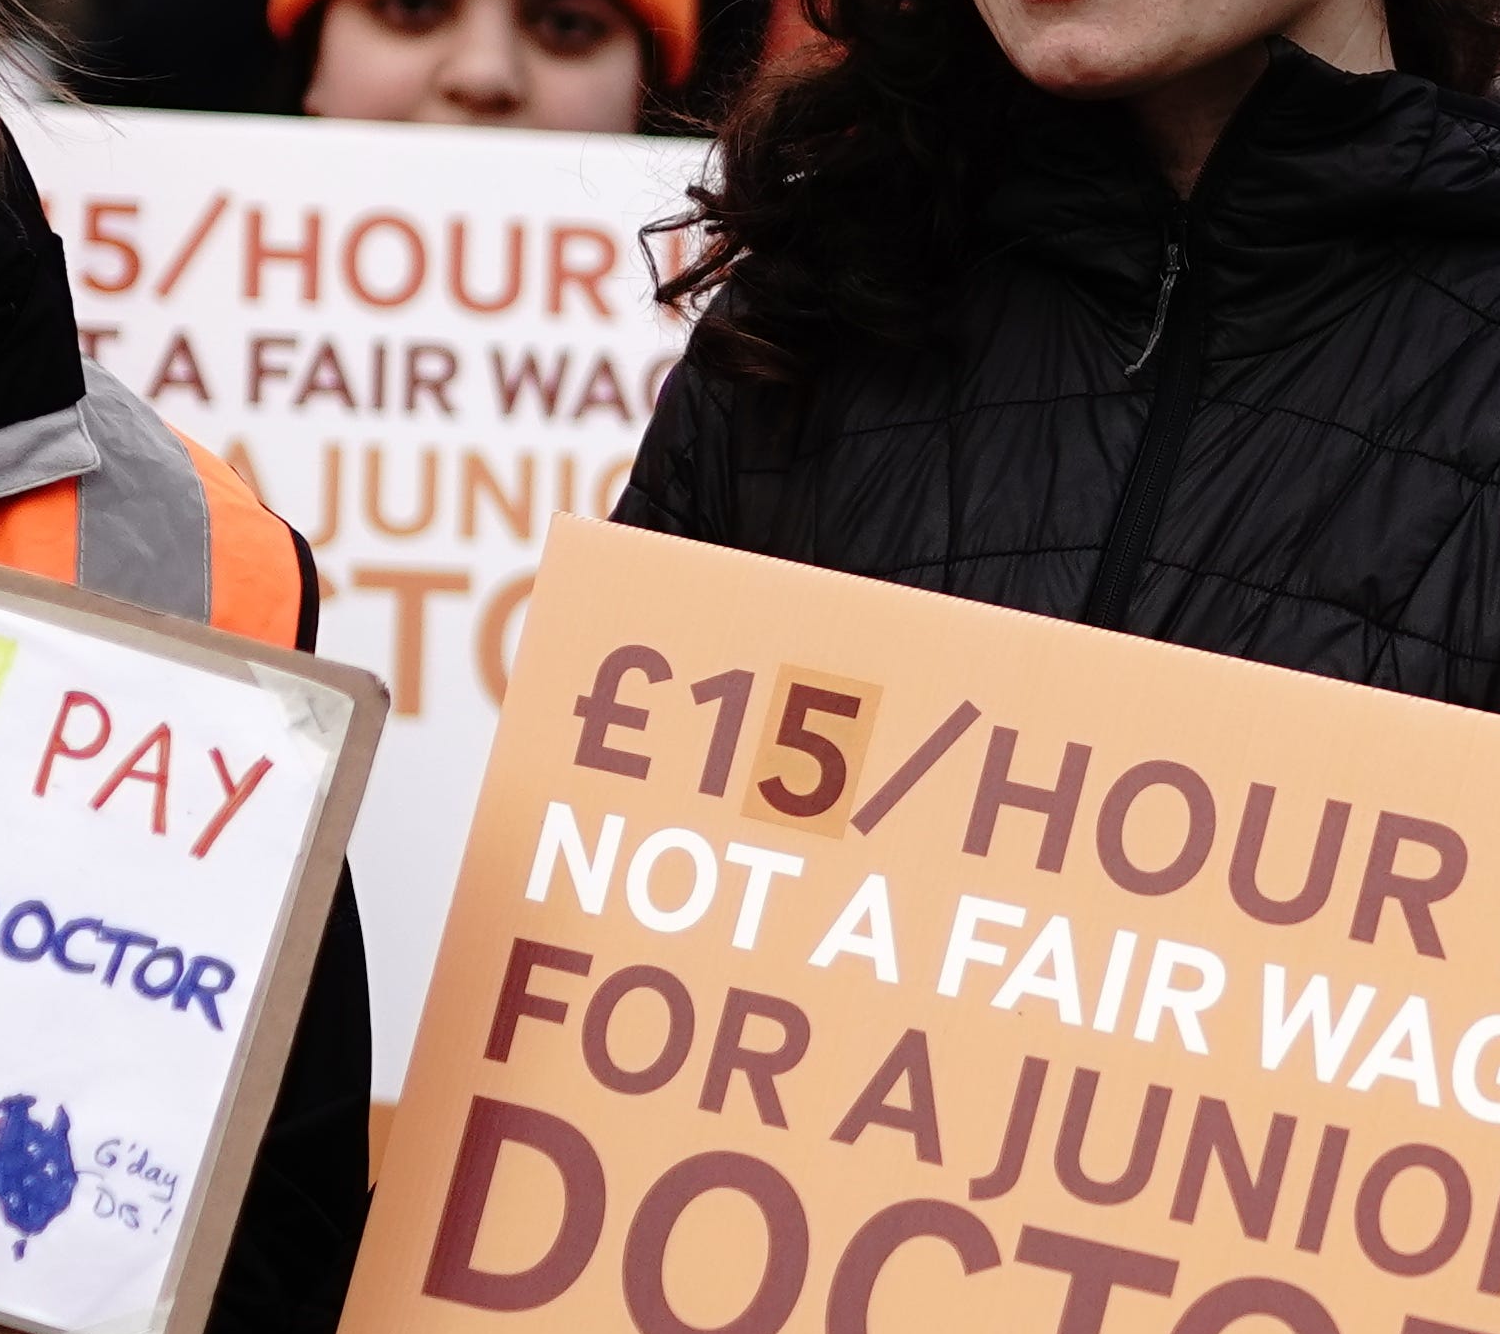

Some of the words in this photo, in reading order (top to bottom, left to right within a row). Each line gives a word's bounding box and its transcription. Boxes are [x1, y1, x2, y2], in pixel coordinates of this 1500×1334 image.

[40, 189, 622, 323] 5/HOUR
[145, 325, 212, 406] A
[245, 329, 462, 415] FAIR
[31, 688, 273, 861] PAY
[573, 644, 1470, 961] £15/HOUR
[524, 801, 806, 951] NOT
[809, 873, 902, 985] A
[937, 893, 1228, 1056] FAIR
[483, 936, 812, 1131] FOR
[831, 1026, 943, 1165] A
